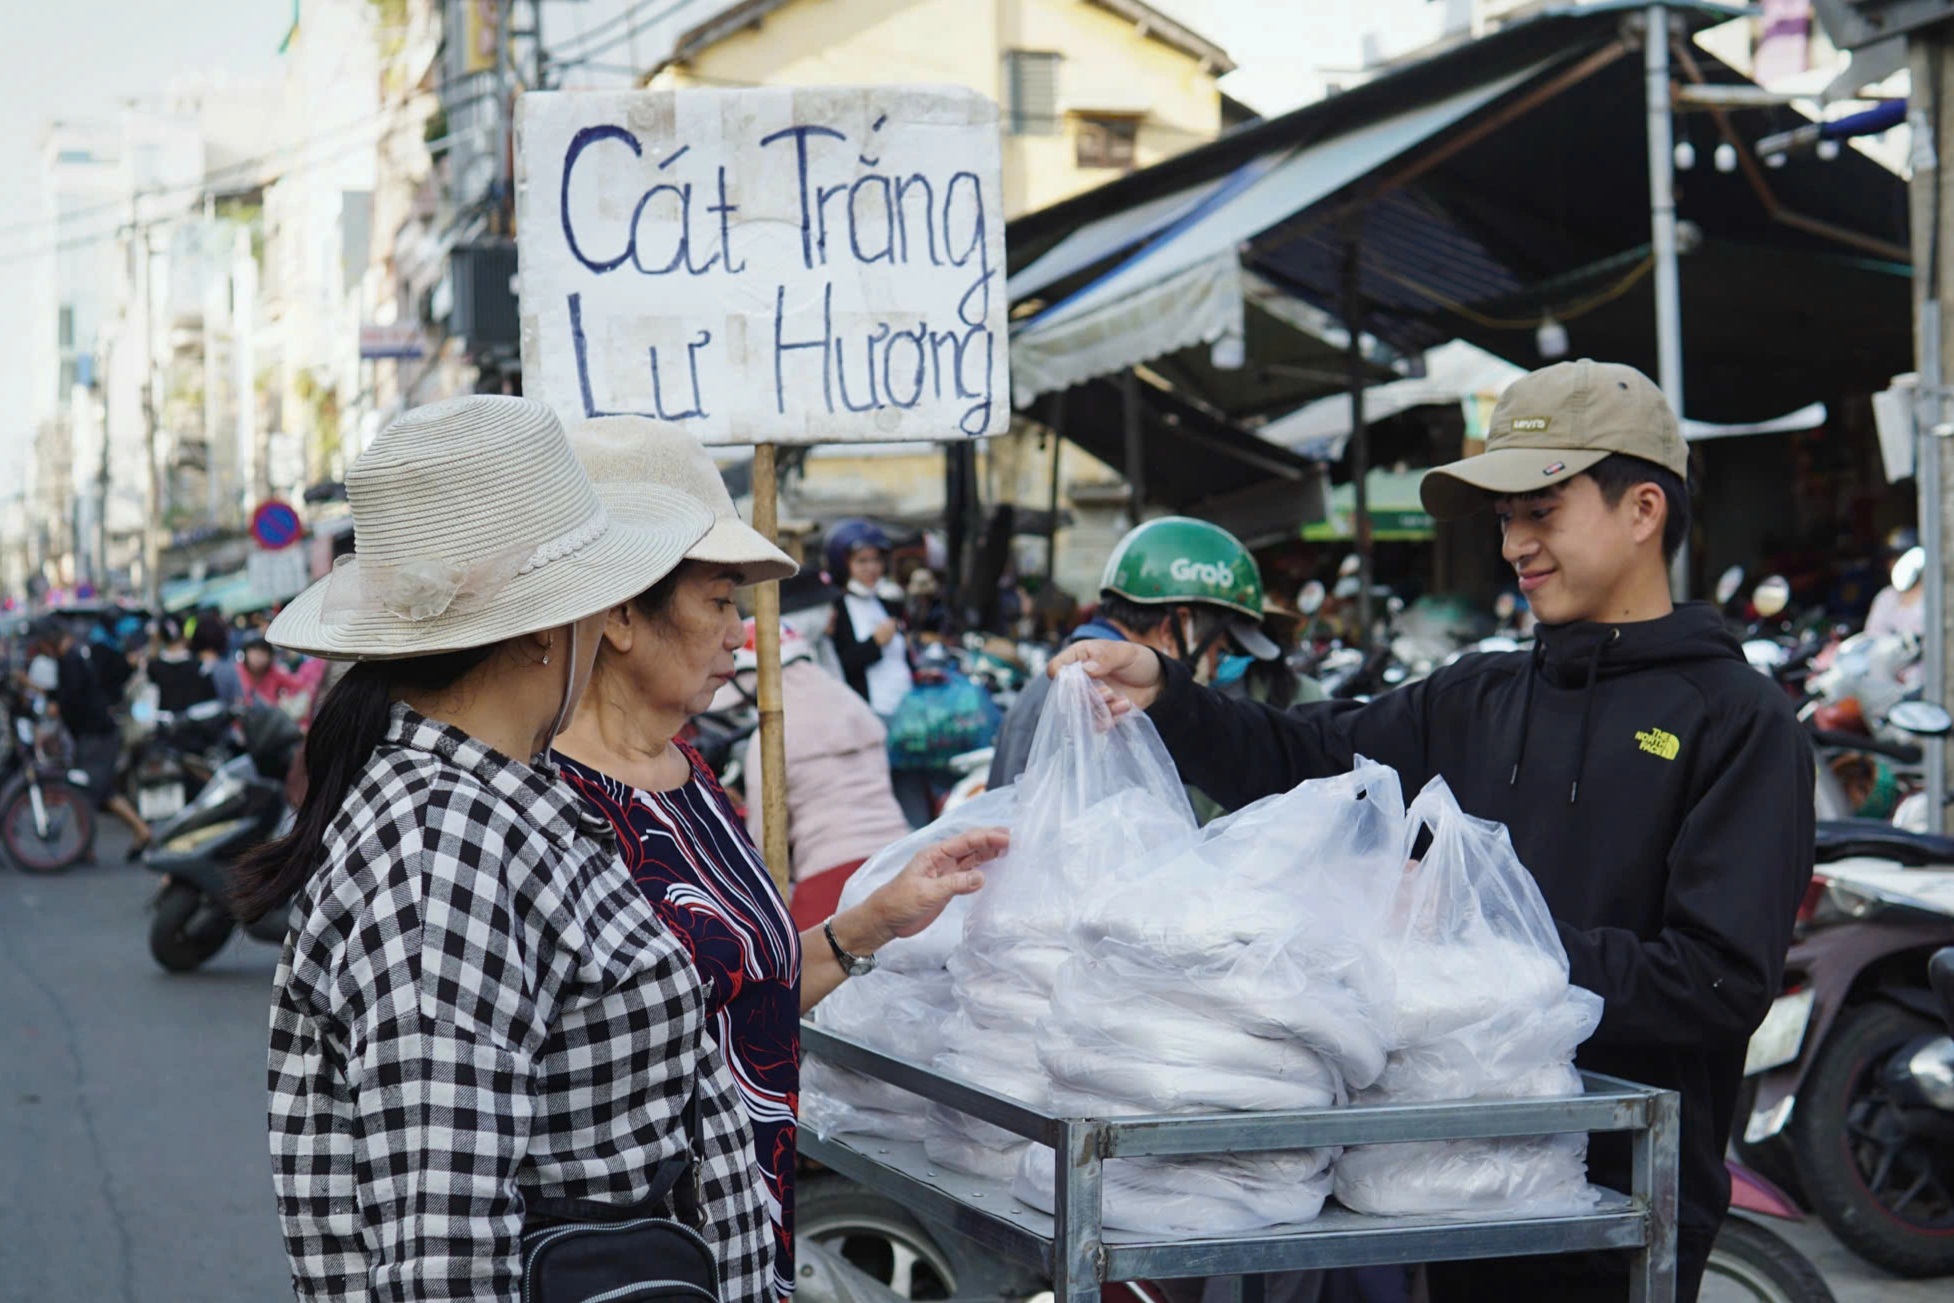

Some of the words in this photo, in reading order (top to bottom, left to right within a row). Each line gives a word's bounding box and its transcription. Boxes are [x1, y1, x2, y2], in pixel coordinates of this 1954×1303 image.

[561, 124, 746, 275] Cát
[760, 114, 997, 326] Trắng
[567, 293, 711, 421] Lư
[774, 282, 994, 436] Hương
[1170, 558, 1234, 589] Grab
[1635, 731, 1668, 749] NORTH
